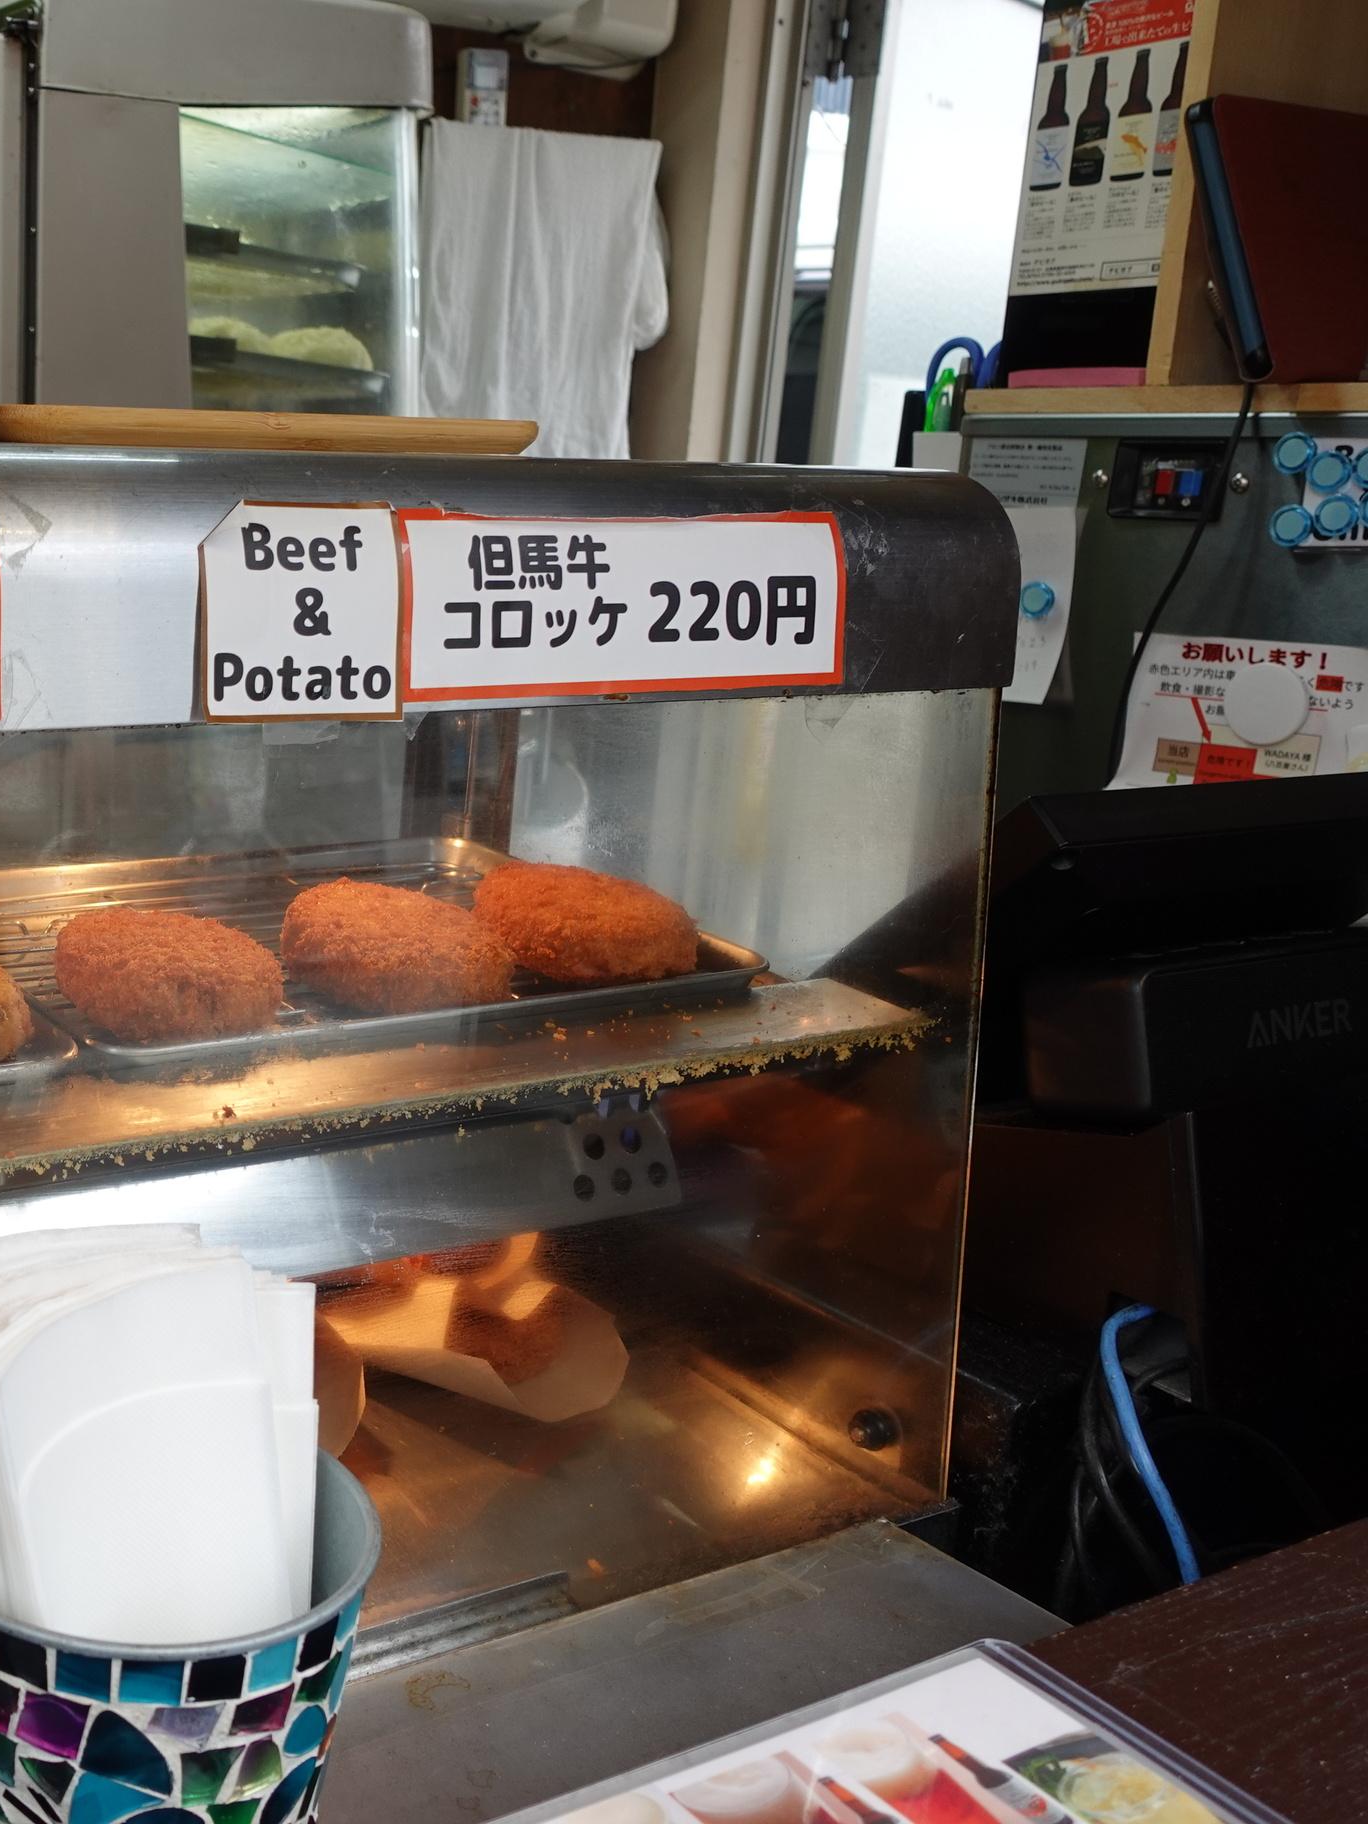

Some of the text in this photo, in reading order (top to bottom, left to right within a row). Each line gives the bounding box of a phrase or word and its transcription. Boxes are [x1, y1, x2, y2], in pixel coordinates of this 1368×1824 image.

[241, 522, 363, 572] Beef
[468, 534, 610, 591] 但馬牛
[293, 587, 332, 636] &
[443, 575, 817, 649] コロッケ 220円
[213, 652, 392, 702] Potato
[1246, 998, 1352, 1048] ANKER
